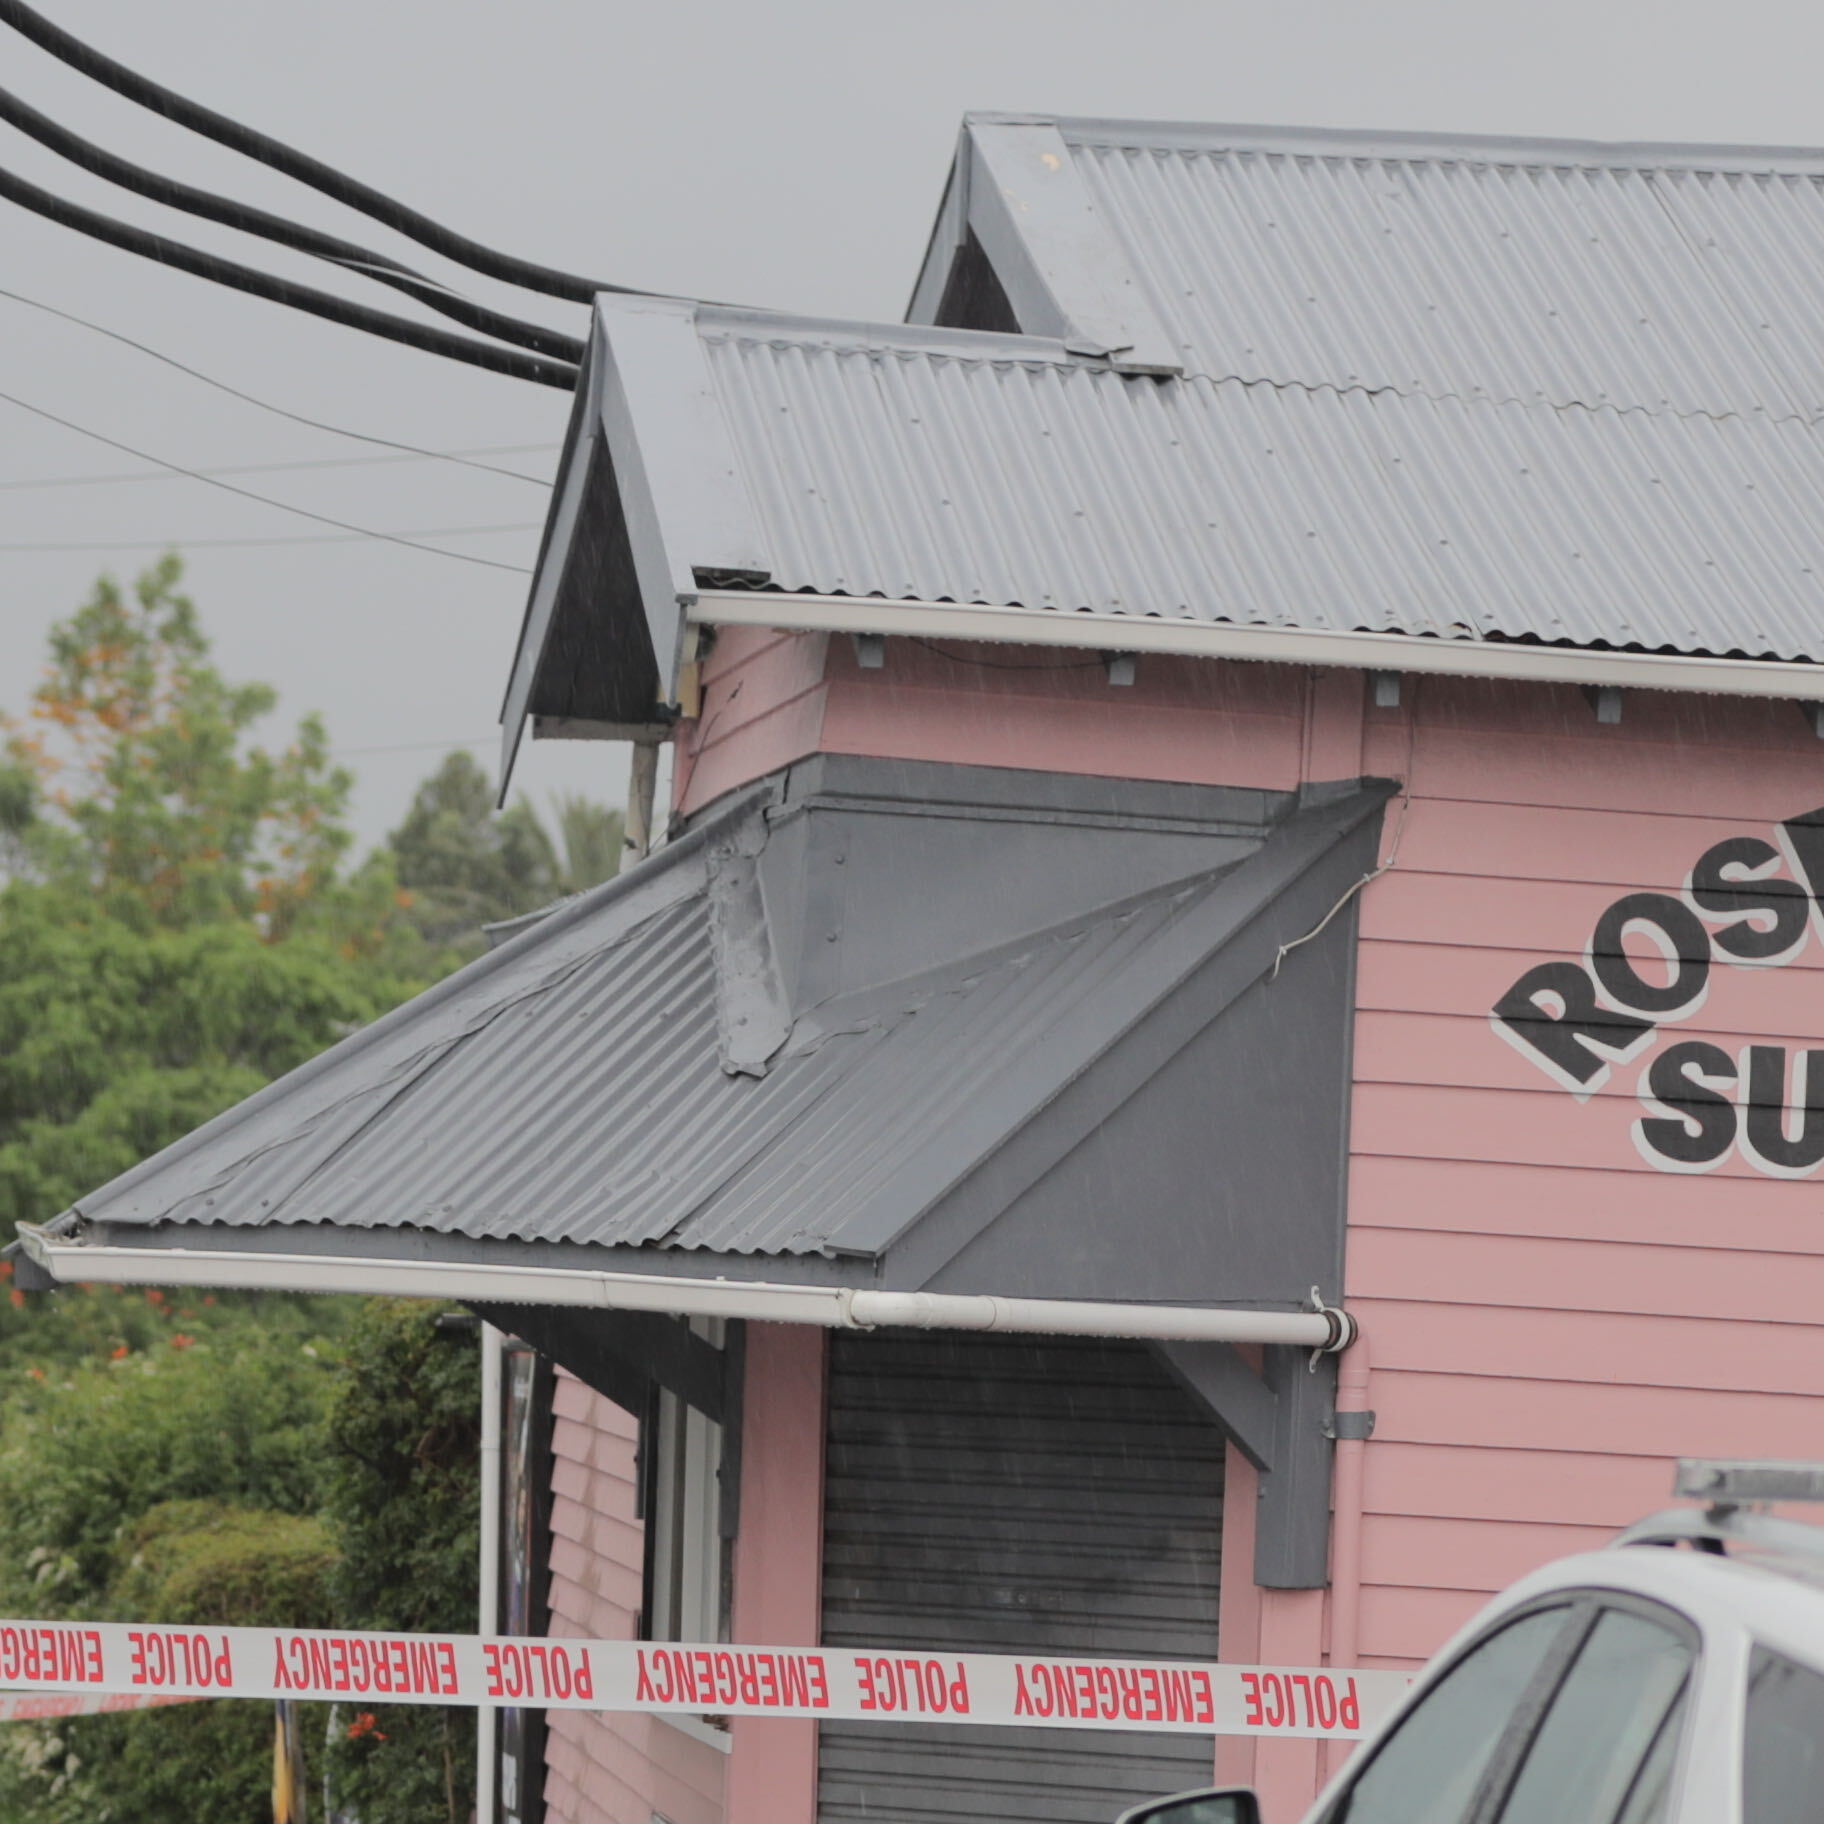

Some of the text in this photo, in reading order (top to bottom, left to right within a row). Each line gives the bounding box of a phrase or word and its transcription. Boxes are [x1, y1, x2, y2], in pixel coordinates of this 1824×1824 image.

[130, 1631, 233, 1687] POLICE
[274, 1636, 459, 1695] EMERGENCY
[484, 1644, 593, 1700] POLICE
[636, 1649, 829, 1708] EMERGENCY
[856, 1657, 970, 1713] POLICE
[1015, 1664, 1215, 1723] EMERGENCY
[1241, 1673, 1360, 1730] POLICE
